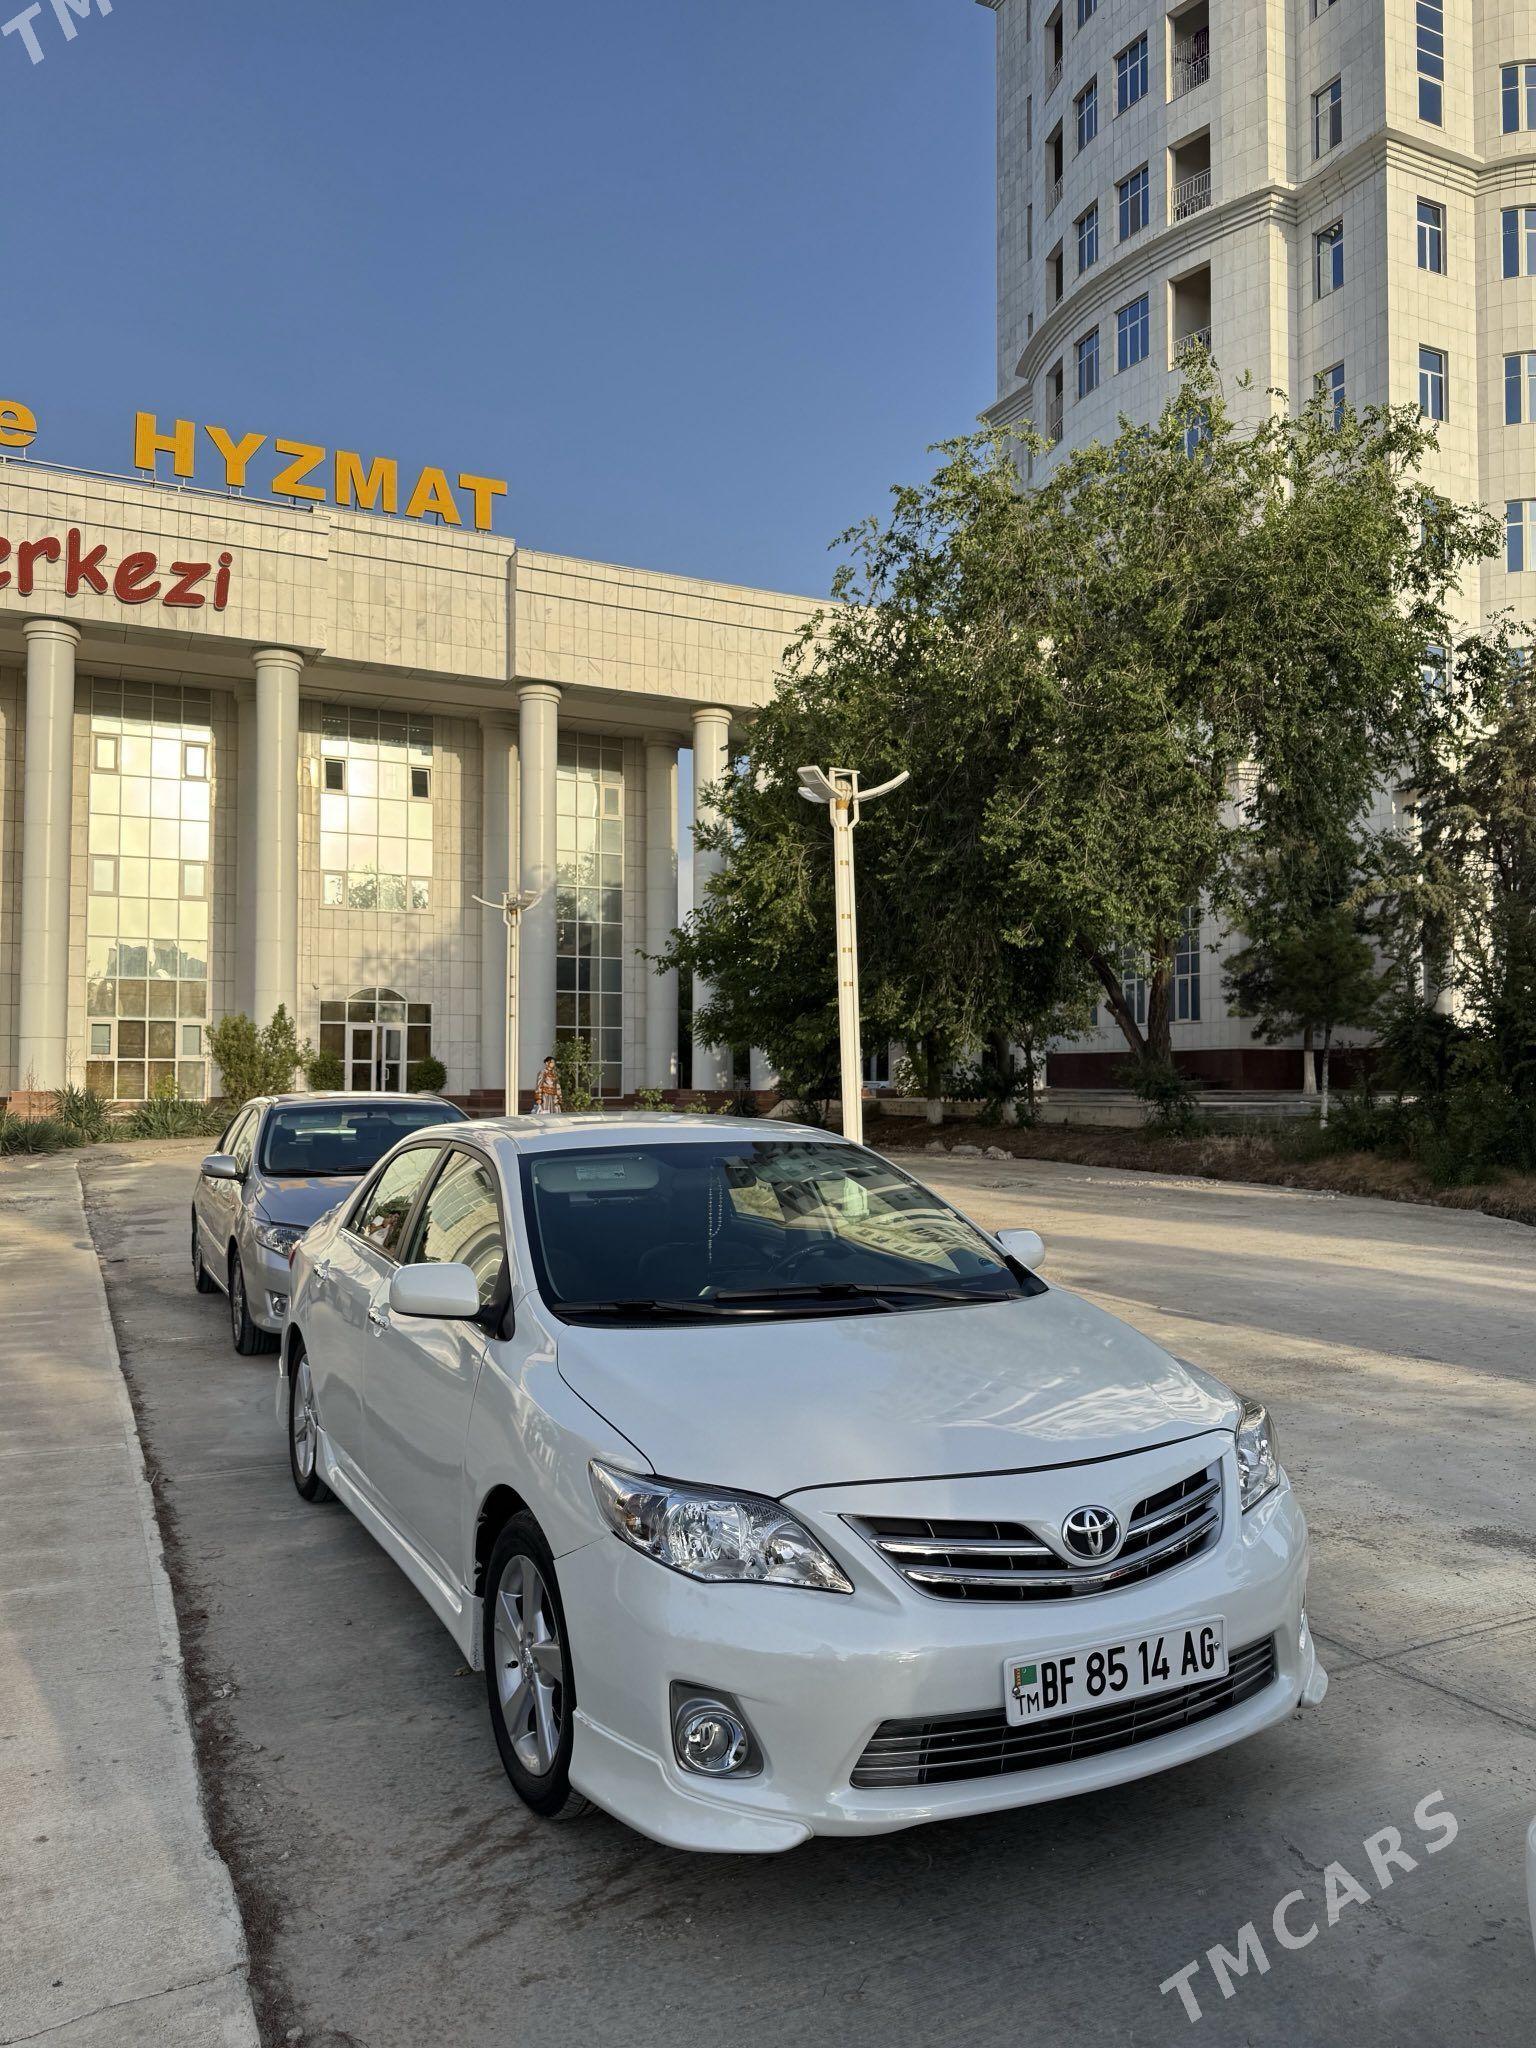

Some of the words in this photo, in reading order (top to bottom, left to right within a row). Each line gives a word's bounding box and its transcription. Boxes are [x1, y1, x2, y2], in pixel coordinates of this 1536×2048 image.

[134, 411, 507, 532] HYZMAT
[0, 527, 233, 611] rkezi
[1015, 1691, 1040, 1716] TM
[1041, 1656, 1076, 1709] BF
[1086, 1645, 1128, 1697] 85
[1138, 1636, 1170, 1686] 14
[1181, 1626, 1215, 1676] AG
